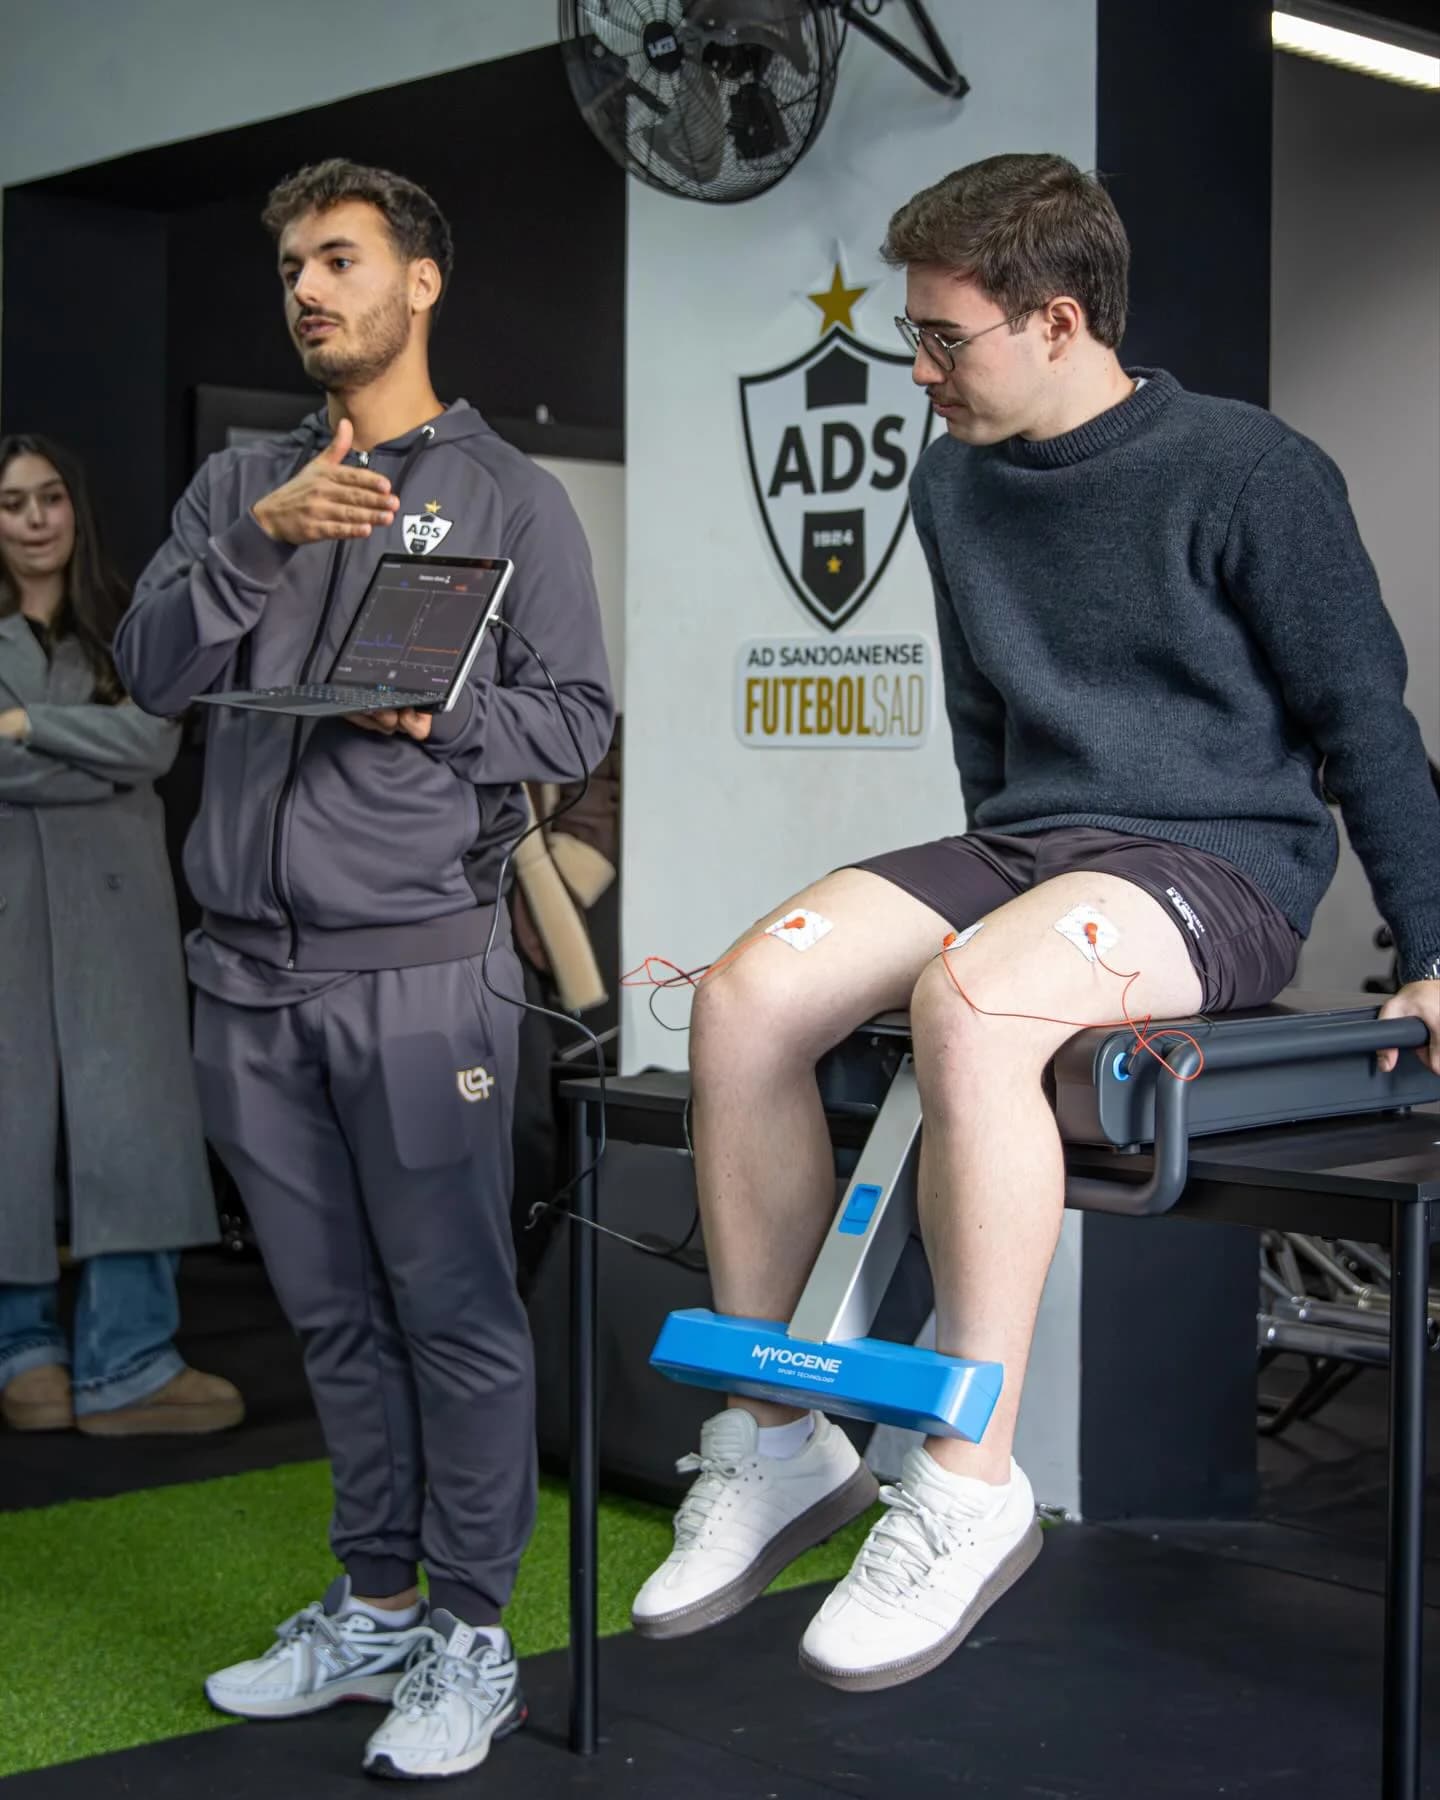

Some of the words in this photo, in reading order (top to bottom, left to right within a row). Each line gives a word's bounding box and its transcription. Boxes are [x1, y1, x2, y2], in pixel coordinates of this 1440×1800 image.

[768, 414, 908, 498] ADS
[406, 523, 441, 539] ADS
[748, 648, 775, 666] AD
[780, 643, 924, 667] SANJOANENSE
[752, 1344, 843, 1373] MYOCENE
